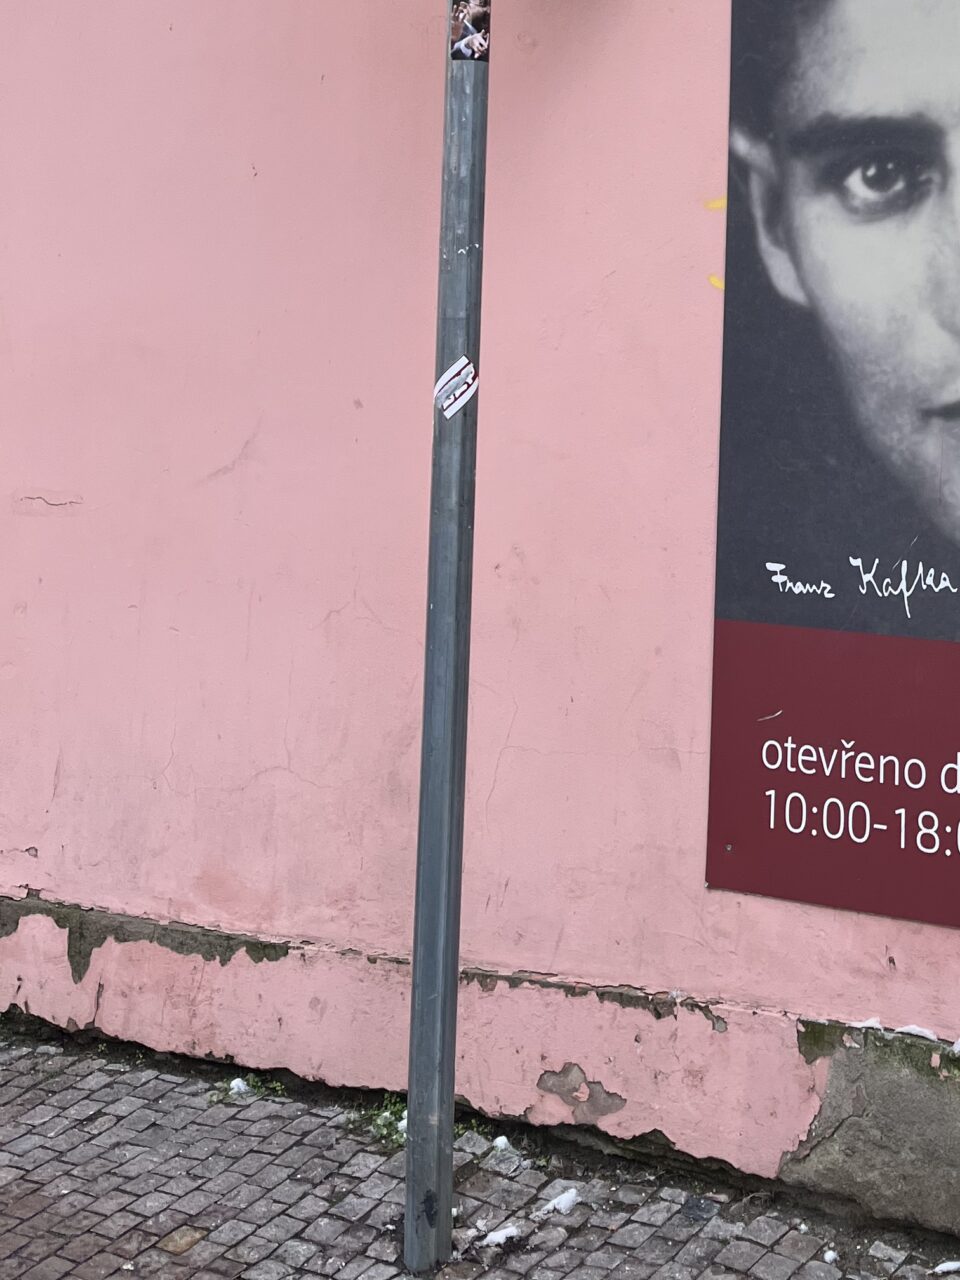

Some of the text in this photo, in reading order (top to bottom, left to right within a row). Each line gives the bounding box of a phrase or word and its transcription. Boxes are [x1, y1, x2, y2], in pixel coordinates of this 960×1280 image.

[765, 556, 958, 619] Franz Kafka
[761, 736, 927, 789] otevřeno
